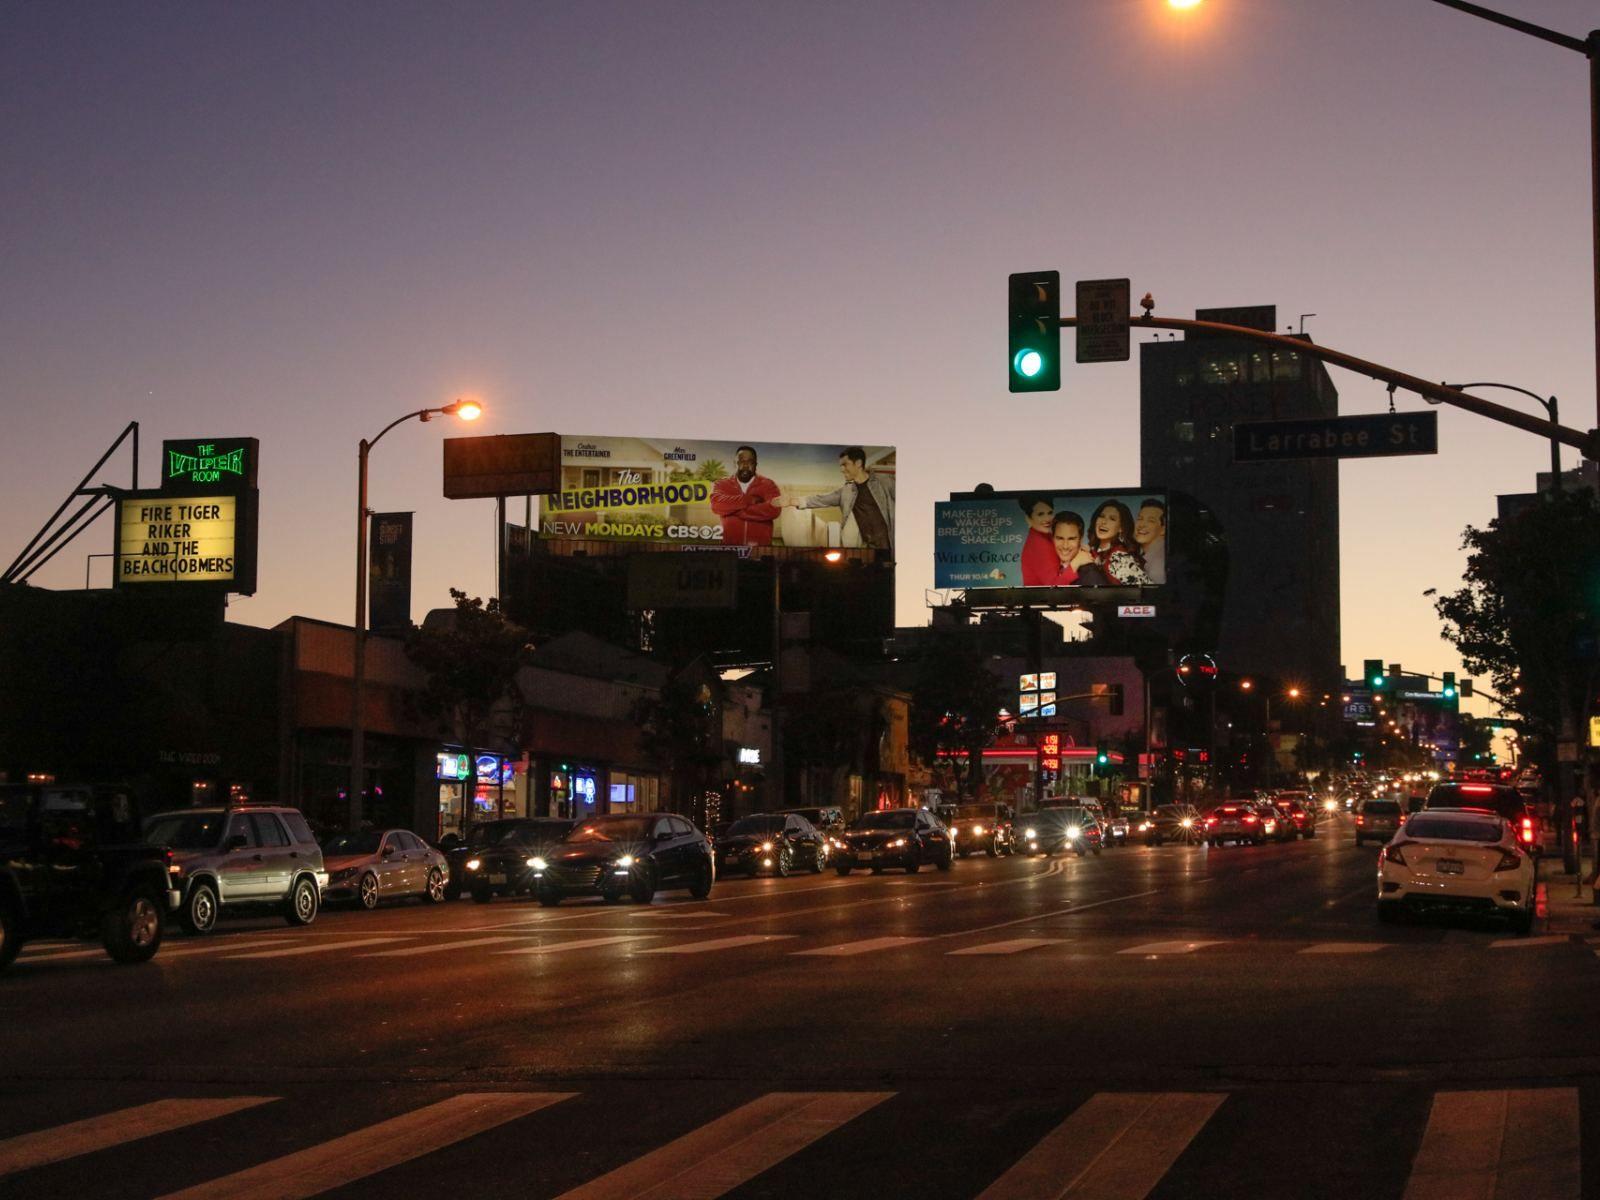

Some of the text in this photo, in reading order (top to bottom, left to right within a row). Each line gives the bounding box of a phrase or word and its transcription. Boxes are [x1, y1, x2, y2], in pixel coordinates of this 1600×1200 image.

[1250, 423, 1419, 452] Larrabee St
[197, 444, 215, 456] THE
[169, 448, 244, 478] VIPER
[192, 471, 220, 482] ROOM
[617, 468, 642, 486] The
[548, 482, 708, 512] NEIGHBORHOOD
[141, 505, 220, 522] FIRE TIGER
[942, 508, 998, 519] MAKE-UPS
[543, 521, 582, 535] NEW
[585, 522, 664, 537] MONDAYS
[955, 517, 1013, 527] WAKE-UPS
[148, 523, 191, 539] RIKER
[937, 526, 999, 536] BREAK-UPS
[961, 534, 1023, 544] SHAKE-UPS
[143, 540, 199, 556] AND THE
[1123, 606, 1151, 615] ACE
